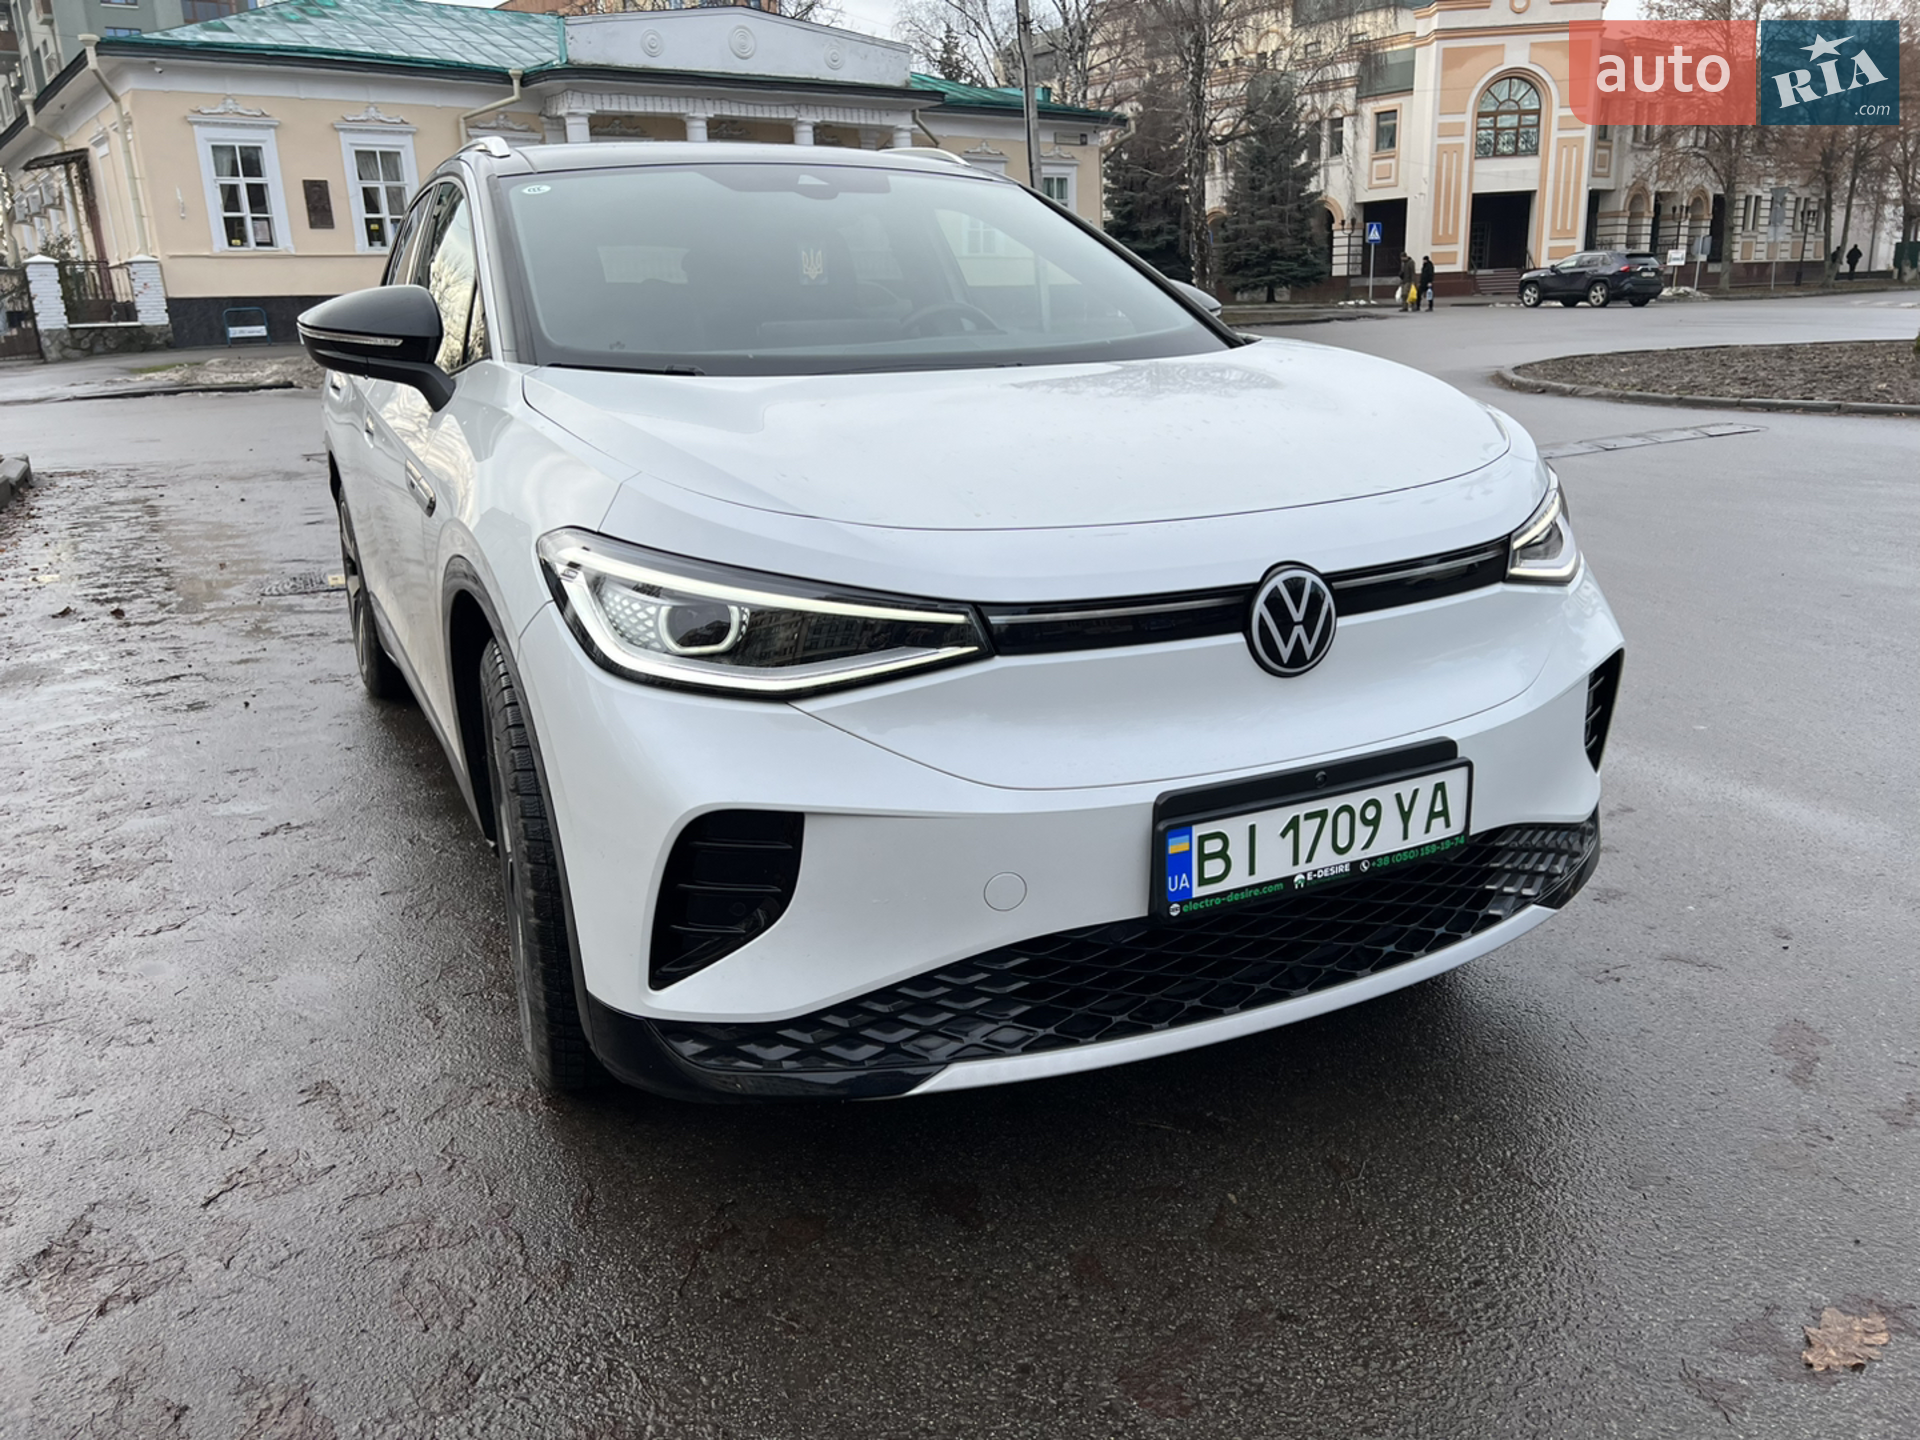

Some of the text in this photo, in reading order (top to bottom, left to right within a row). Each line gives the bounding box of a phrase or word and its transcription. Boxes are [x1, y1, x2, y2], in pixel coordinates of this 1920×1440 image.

[1197, 781, 1451, 887] BI 1709 YA
[1168, 873, 1190, 892] UA
[1182, 881, 1284, 912] electro-desire.com
[1306, 863, 1350, 881] E-DESIRE
[1371, 856, 1390, 868] +38
[1391, 849, 1419, 864] (050)
